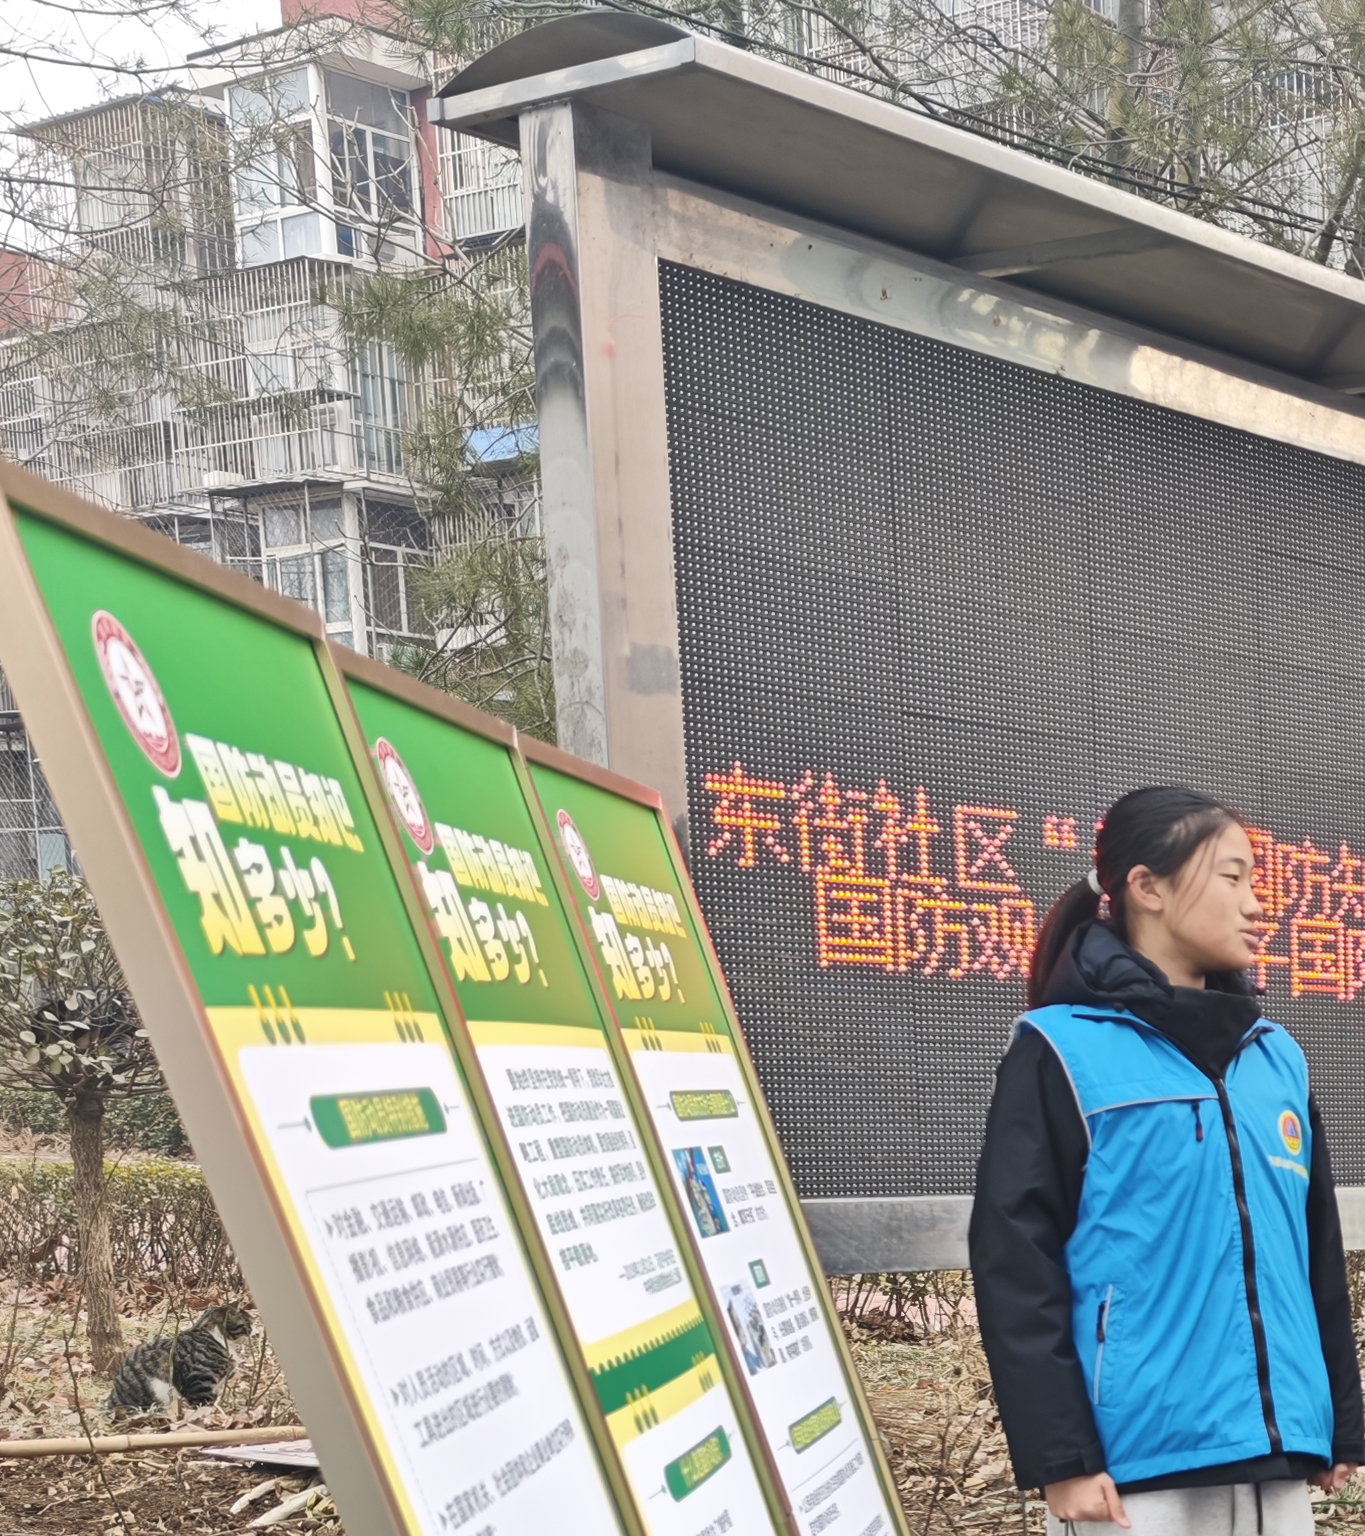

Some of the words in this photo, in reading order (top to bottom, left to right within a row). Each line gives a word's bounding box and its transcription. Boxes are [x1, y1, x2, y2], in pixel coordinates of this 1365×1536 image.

[152, 785, 357, 961] 知多少?
[417, 861, 549, 988] 知多少?
[588, 905, 685, 1004] 知多少?
